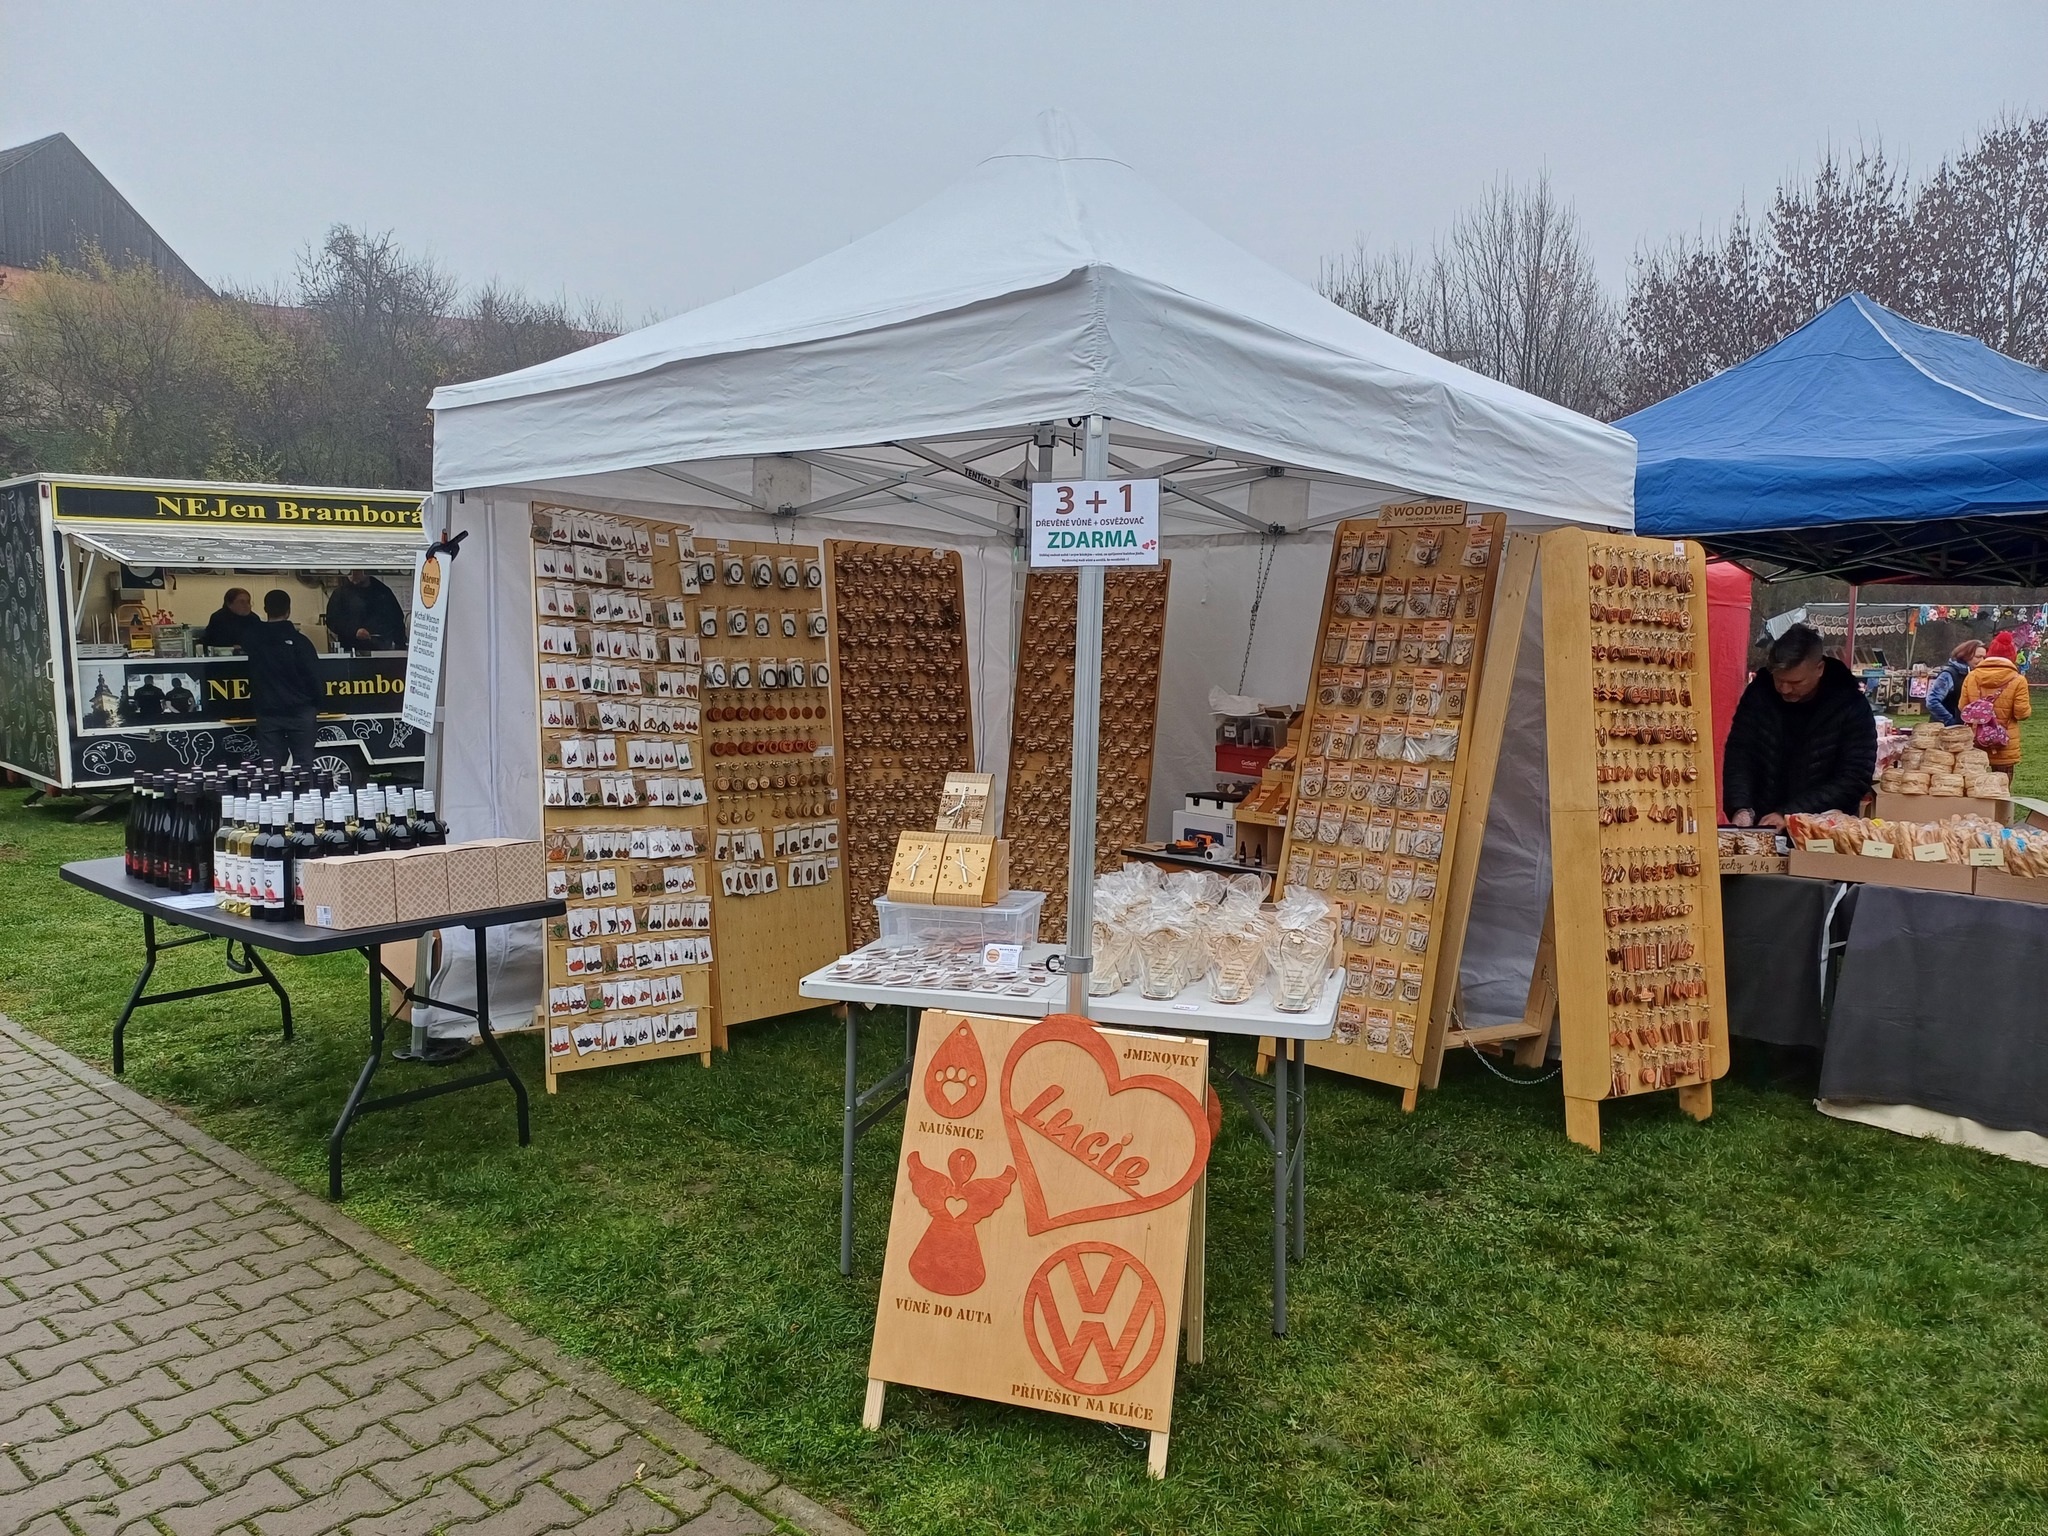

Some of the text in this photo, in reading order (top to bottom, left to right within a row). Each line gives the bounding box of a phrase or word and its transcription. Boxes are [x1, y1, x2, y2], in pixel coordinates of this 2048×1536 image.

[155, 496, 266, 520] NEJen
[1056, 486, 1075, 515] 3
[1119, 484, 1132, 513] 1
[1394, 504, 1462, 517] WOODVIBE
[1036, 518, 1070, 527] DŘEVĚNÉ
[1071, 517, 1092, 527] VŮNĚ
[1100, 516, 1144, 526] OSVĚŽOVAČ
[1047, 530, 1137, 549] ZDARMA
[1719, 858, 1745, 874] echy
[1123, 1048, 1199, 1068] JMENOVKY
[918, 1121, 985, 1141] NAUŠNICE
[1021, 1084, 1150, 1186] Lucie
[895, 1297, 993, 1325] VŮNĚ DO AUTA
[1011, 1383, 1153, 1422] PŘÍVĚŠKY NA KLÍČE
